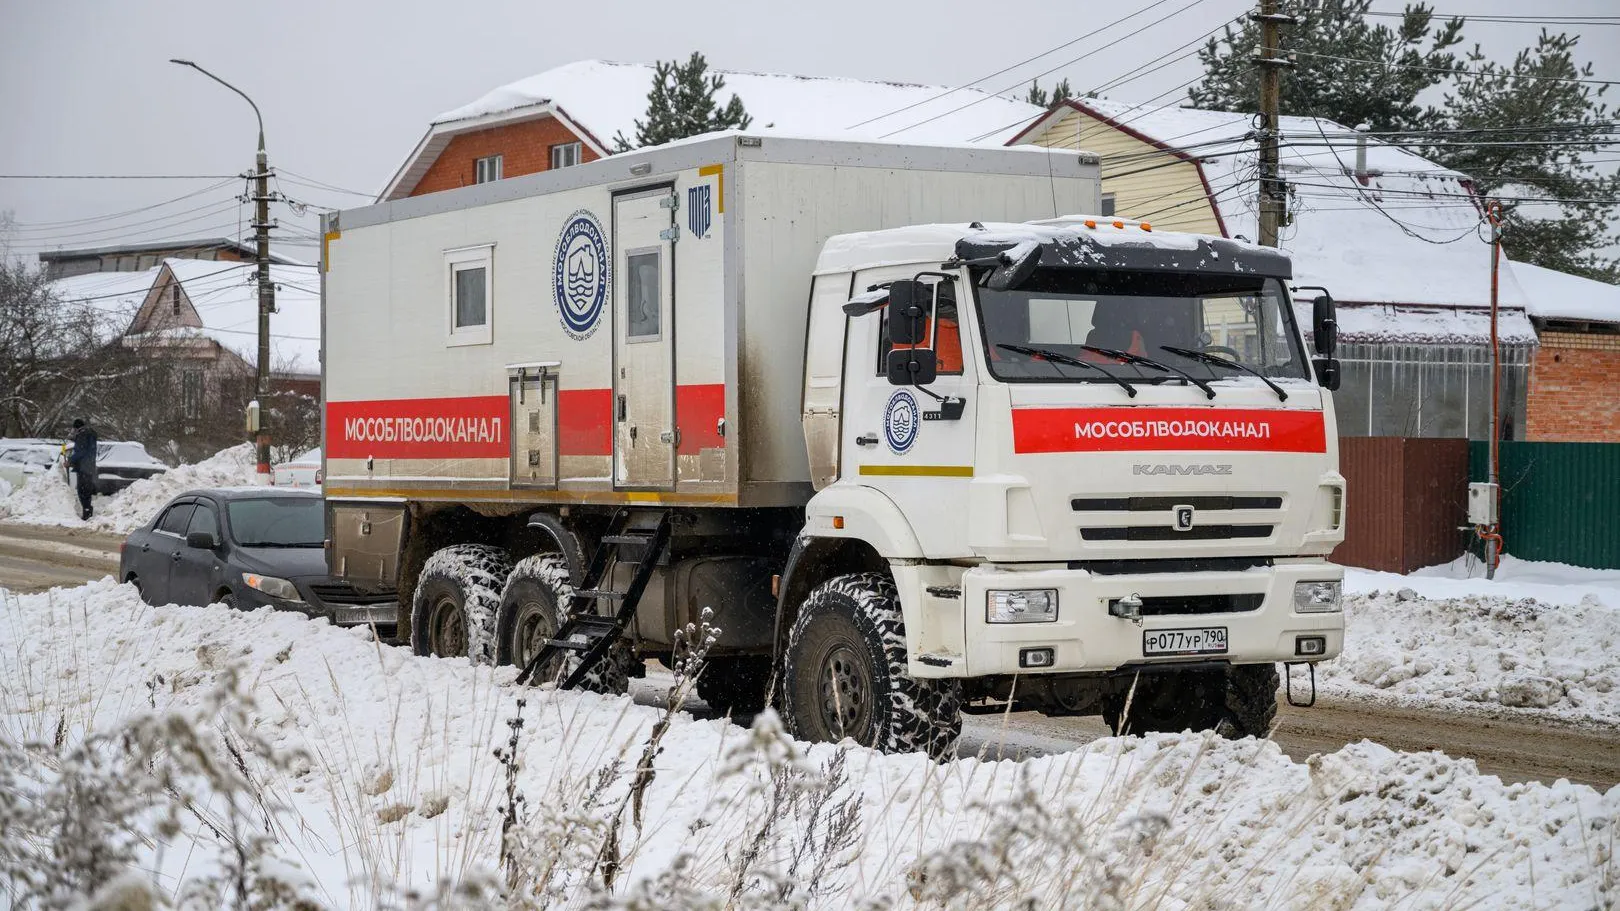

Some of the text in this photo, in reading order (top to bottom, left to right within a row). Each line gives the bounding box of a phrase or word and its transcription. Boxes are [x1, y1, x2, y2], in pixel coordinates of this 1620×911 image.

[557, 222, 606, 286] МОСОБЛВОДОКАНАЛ
[345, 417, 501, 443] МОСОБЛВОДОКАНАЛ
[1074, 421, 1270, 439] МОСОБЛВОДОКАНАЛ
[1132, 464, 1233, 475] KAMAZ
